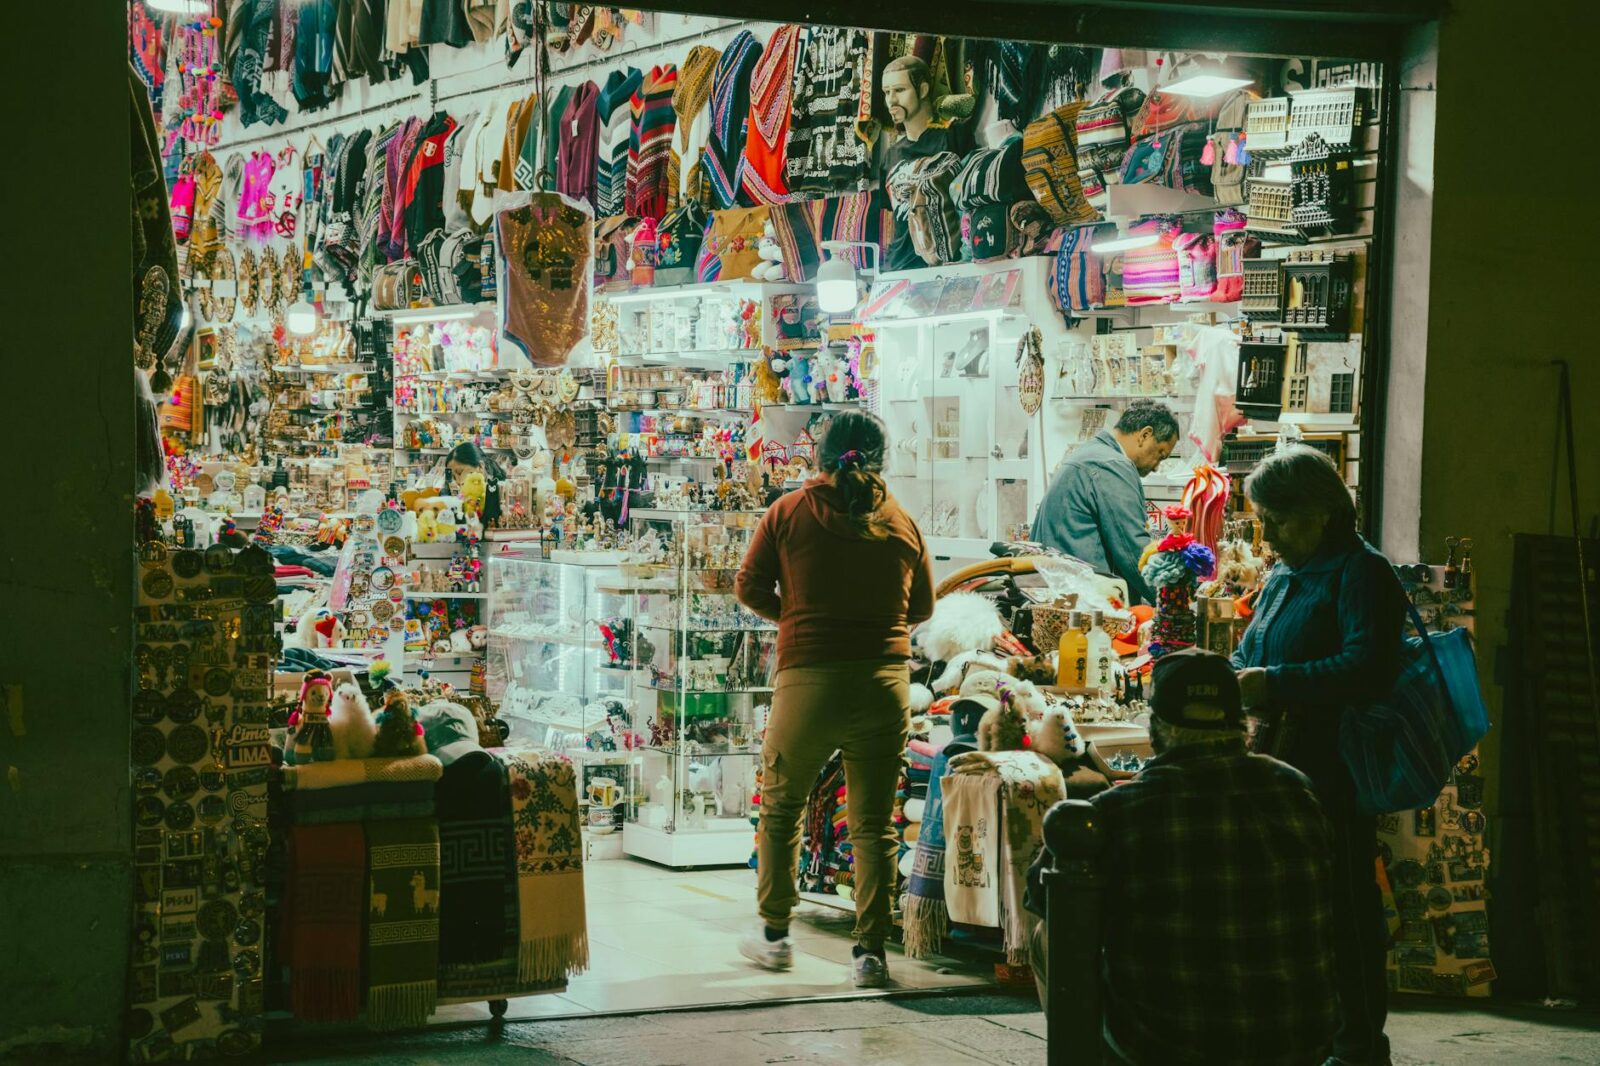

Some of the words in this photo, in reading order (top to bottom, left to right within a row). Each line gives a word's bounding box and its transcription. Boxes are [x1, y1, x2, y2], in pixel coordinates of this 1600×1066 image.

[361, 591, 388, 602] Lima
[226, 725, 271, 745] Lima
[228, 746, 272, 767] LIMA
